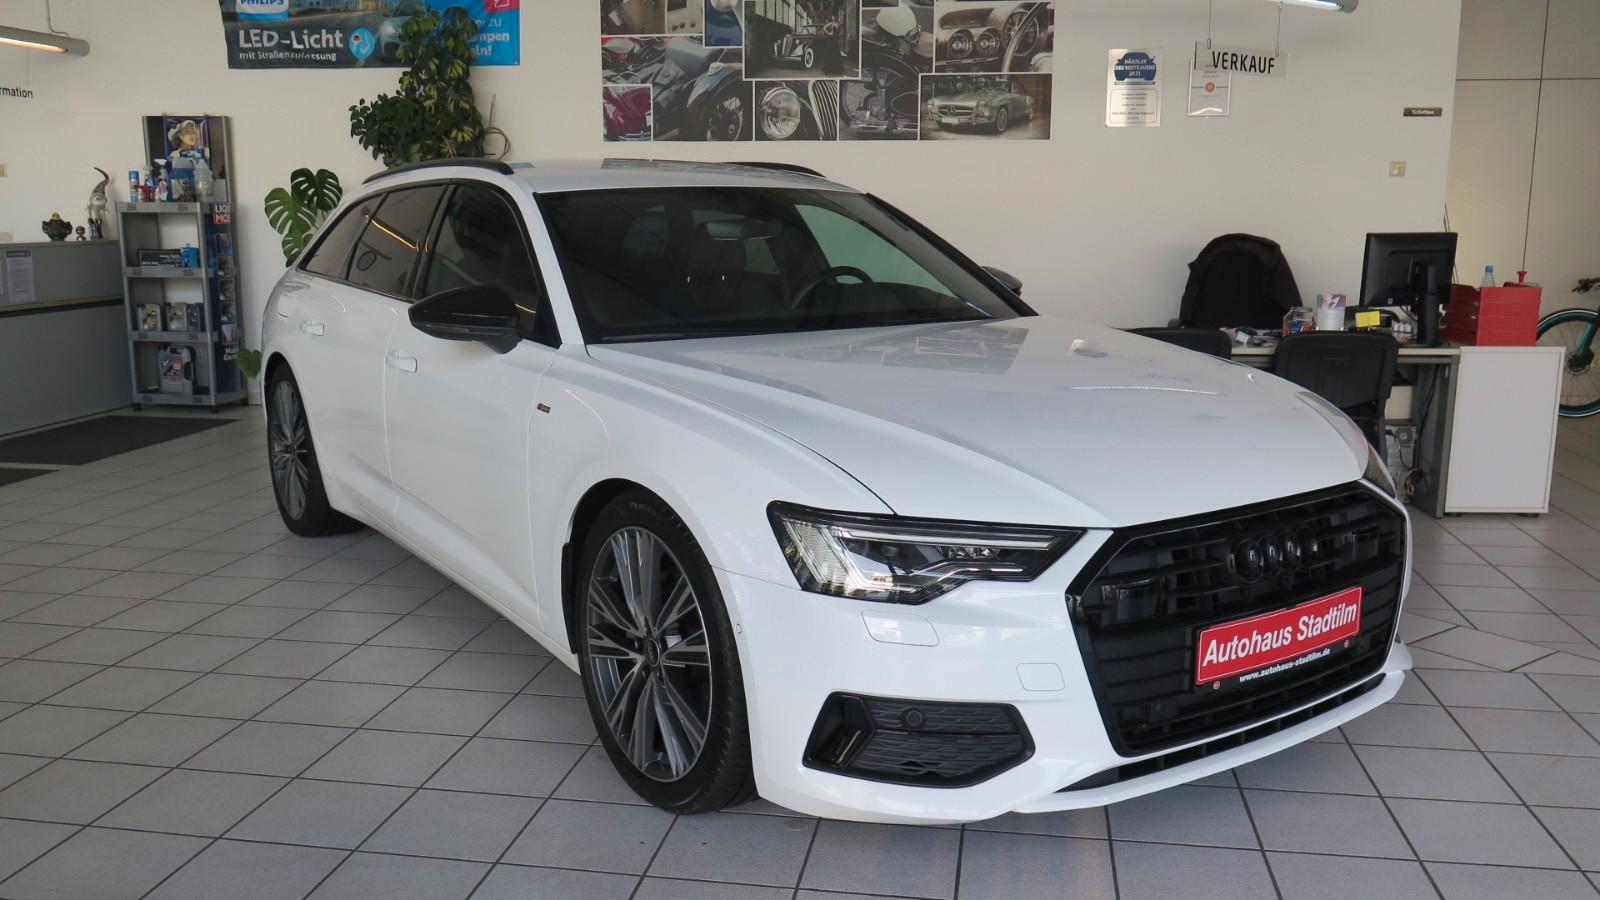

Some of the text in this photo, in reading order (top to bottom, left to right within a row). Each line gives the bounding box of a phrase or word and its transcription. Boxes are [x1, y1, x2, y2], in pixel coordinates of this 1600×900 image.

[239, 29, 344, 49] LED-Licht
[239, 51, 256, 60] mit
[1212, 51, 1275, 74] VERKAUF
[1202, 603, 1357, 667] Autohaus Stadtilm
[1239, 648, 1331, 682] www.autohaus-stadtilm.de
